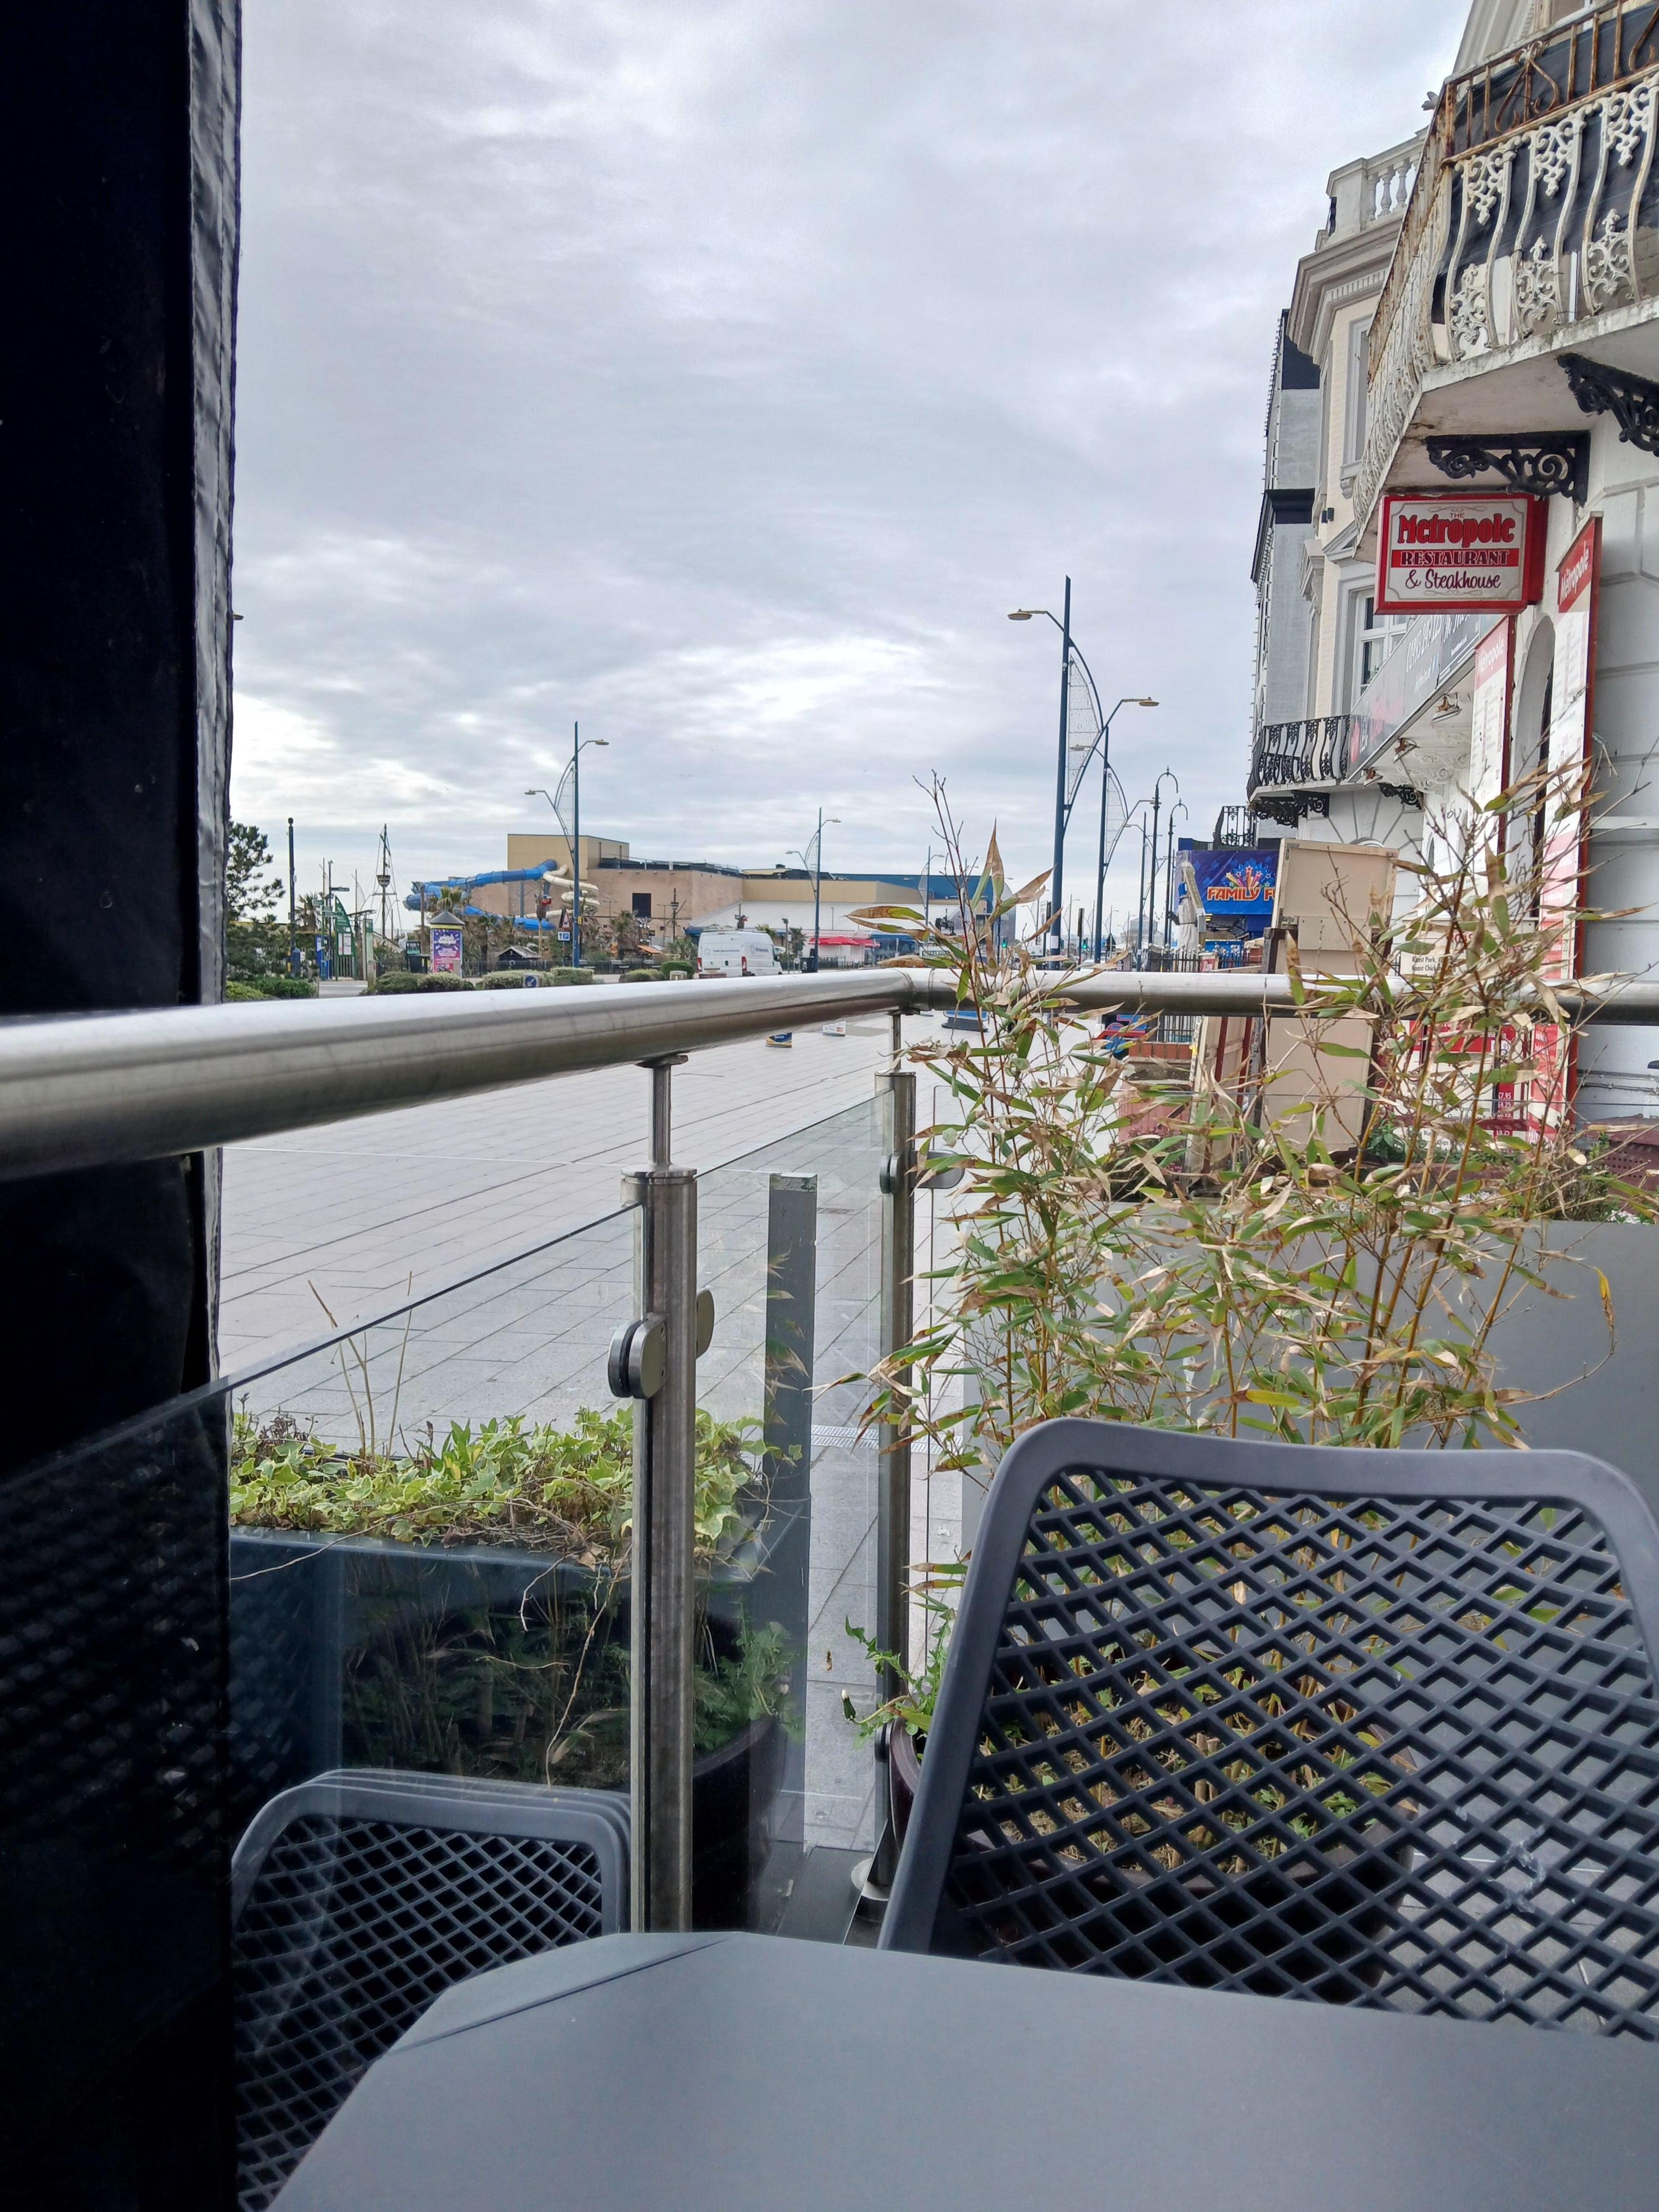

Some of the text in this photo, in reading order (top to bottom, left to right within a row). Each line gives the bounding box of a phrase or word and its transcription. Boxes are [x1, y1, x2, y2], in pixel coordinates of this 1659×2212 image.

[1397, 513, 1516, 548] Metropole
[1400, 550, 1509, 566] RESTAURANT
[1405, 568, 1501, 589] & Steakhouse
[1207, 886, 1261, 901] FAMILY
